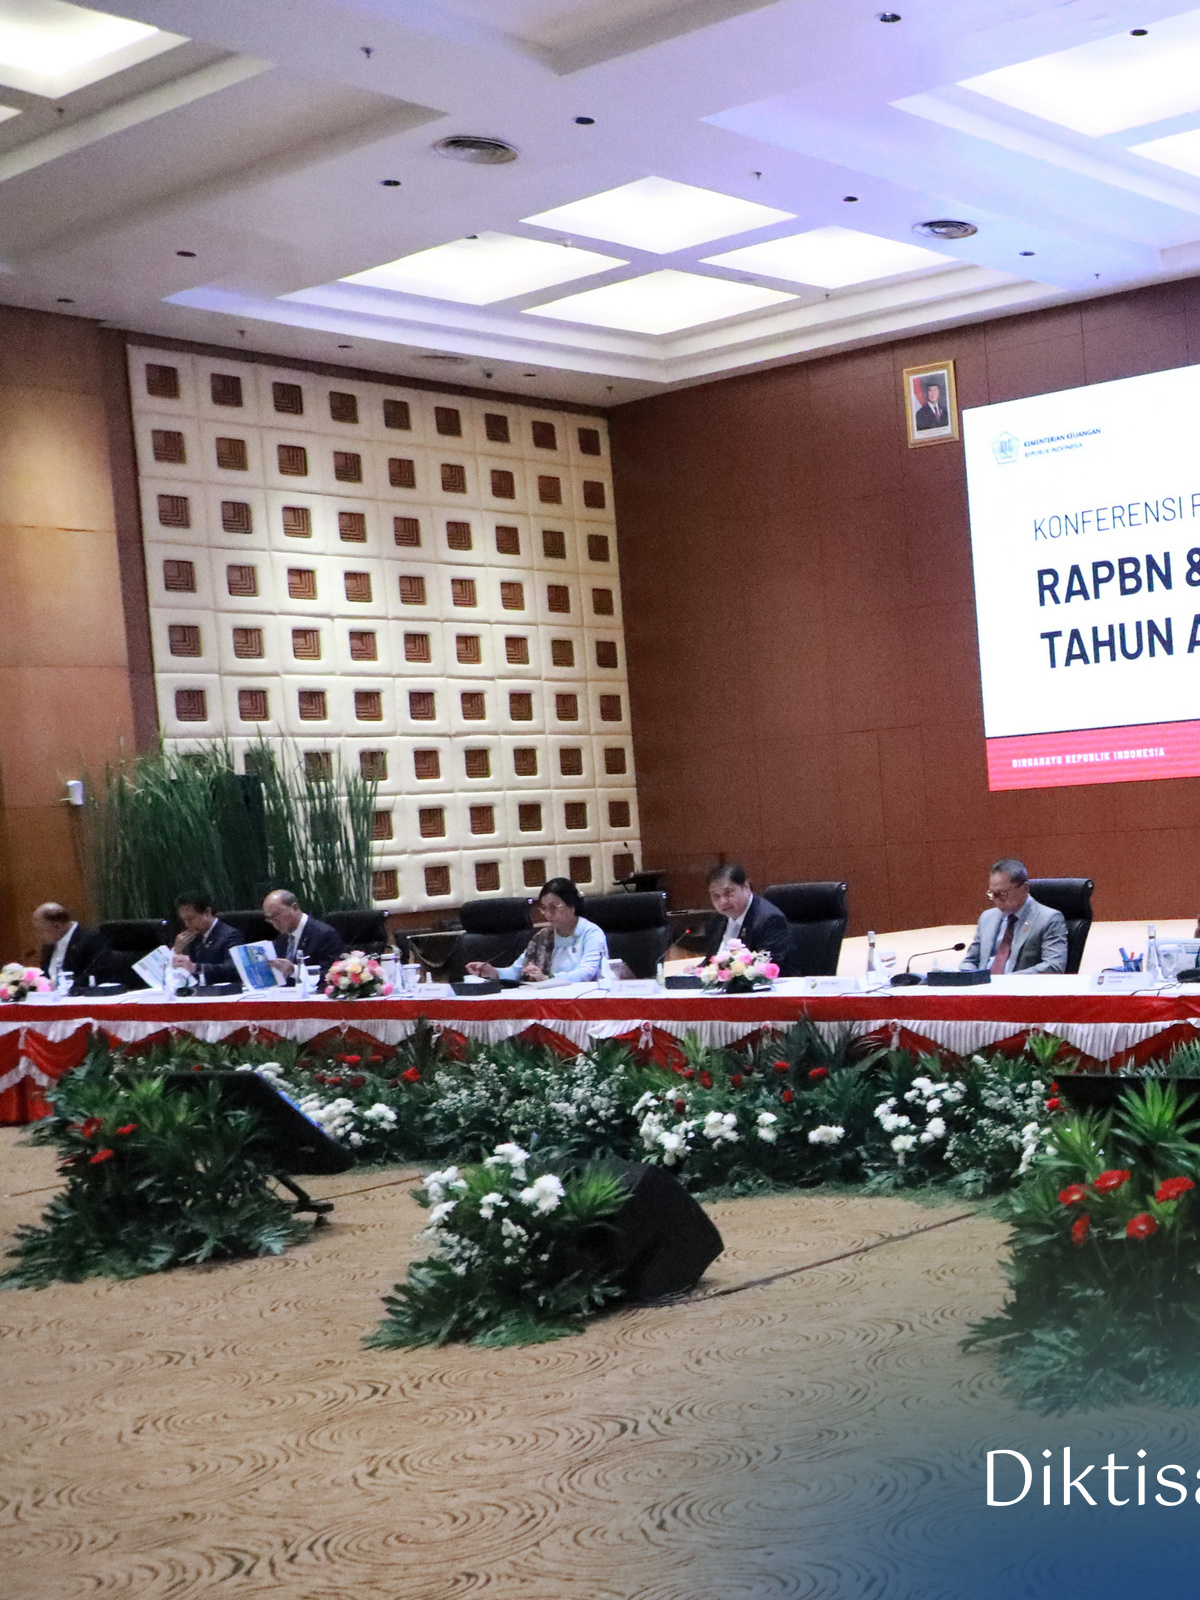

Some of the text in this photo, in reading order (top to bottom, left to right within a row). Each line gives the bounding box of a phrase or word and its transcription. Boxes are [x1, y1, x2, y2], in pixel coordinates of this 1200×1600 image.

[1024, 435, 1065, 447] KEMENTERIAN
[1033, 496, 1183, 541] KONFERENSI
[1037, 551, 1173, 607] RAPBN
[1040, 617, 1174, 669] TAHUN
[1012, 748, 1165, 768] DIRGAHAYU REPUBLIK INDONESIA
